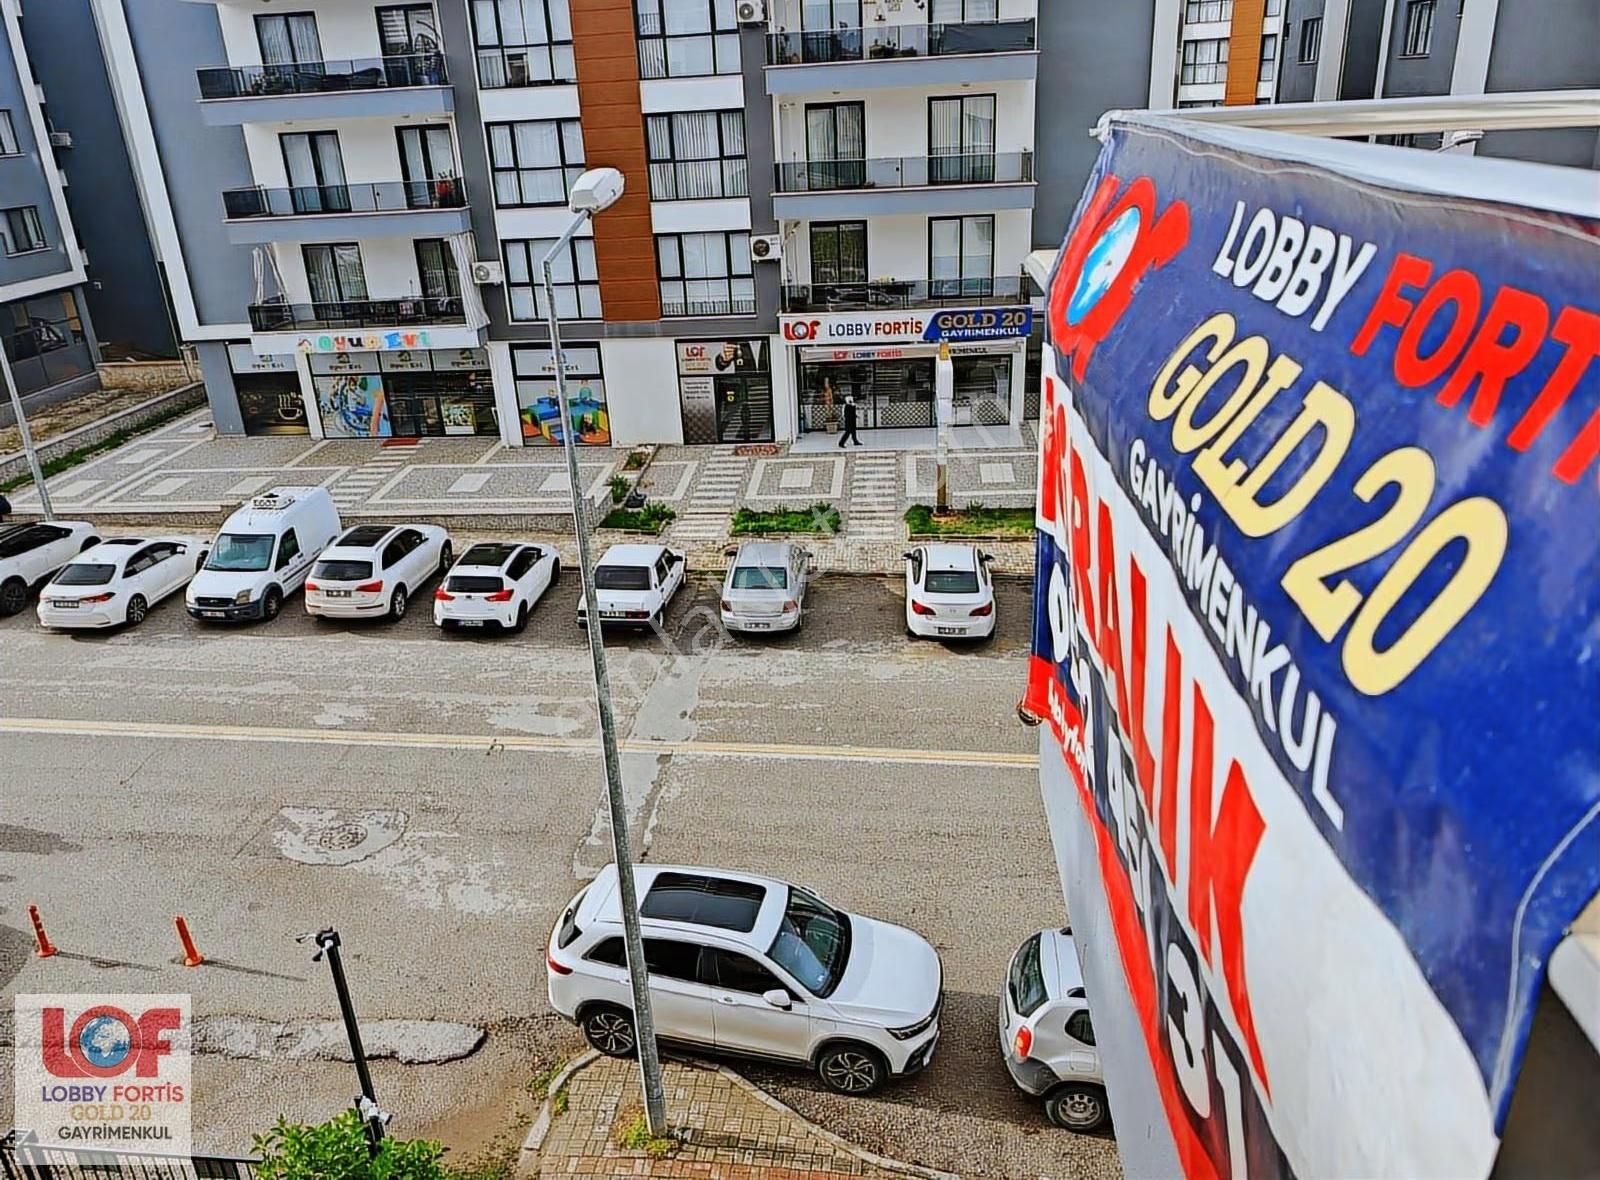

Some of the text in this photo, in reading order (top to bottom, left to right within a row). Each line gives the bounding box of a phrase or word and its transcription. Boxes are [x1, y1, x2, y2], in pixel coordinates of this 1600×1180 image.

[828, 323, 872, 337] LOBBY
[937, 312, 1027, 329] GOLD 20
[1212, 200, 1600, 489] LOBBY FORT
[1129, 438, 1344, 832] GAYRİMENKUL
[1147, 312, 1509, 696] GOLD 20
[1042, 376, 1273, 1107] KRALIK
